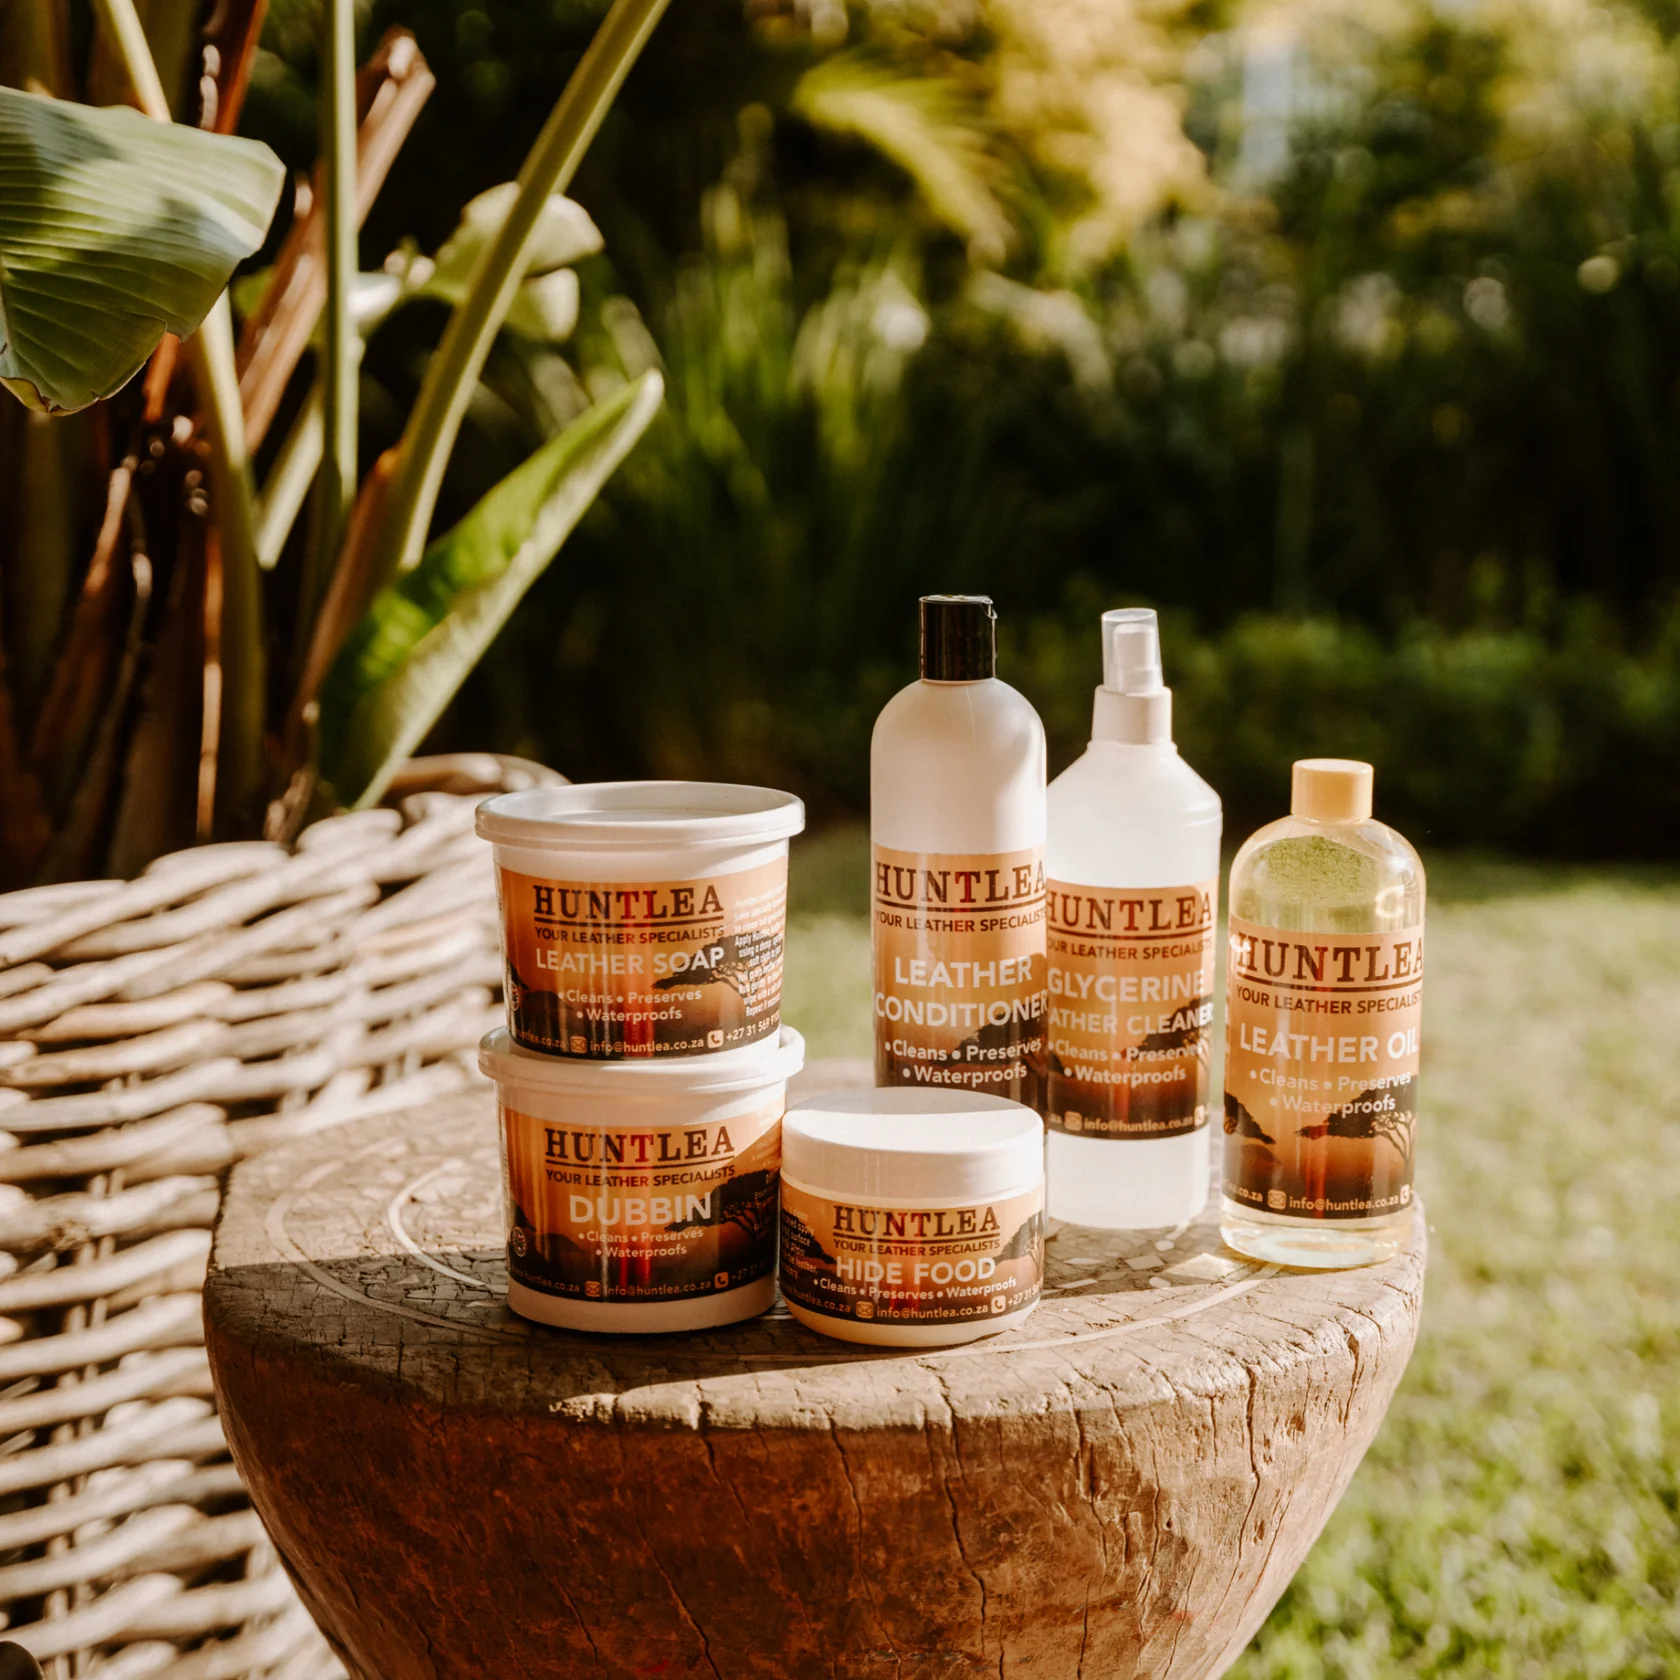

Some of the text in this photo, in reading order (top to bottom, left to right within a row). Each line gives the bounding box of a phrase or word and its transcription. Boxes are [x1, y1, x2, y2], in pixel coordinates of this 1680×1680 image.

[875, 860, 1046, 903] HUNTLEA
[533, 885, 724, 920] HUNTLEA
[534, 926, 724, 945] YOUR LEATHER SPECIALISTS
[906, 916, 975, 932] LEATHER
[536, 947, 644, 976] LEATHER
[653, 946, 724, 974] SOAP
[1071, 943, 1137, 960] LEATHER
[1237, 932, 1423, 982] HUNTLEA
[895, 955, 1032, 988] LEATHER
[567, 988, 702, 1005] Cleans Preserves
[1048, 967, 1205, 1003] GLYCERINE
[876, 989, 1047, 1027] CONDITIONER
[1236, 984, 1270, 1008] YOUR
[1275, 995, 1352, 1014] LEATHER
[586, 1008, 683, 1024] Waterproofs
[1049, 1007, 1117, 1035] ATHER
[590, 1036, 704, 1053] info@huntlea.co.za
[726, 1026, 745, 1042] +27
[746, 1024, 756, 1037] 31
[893, 1038, 1041, 1061] Cleans Preserves
[1056, 1039, 1108, 1062] Cleans
[1240, 1022, 1419, 1063] LEATHER OIL
[914, 1064, 1027, 1087] Waterproofs
[1075, 1064, 1186, 1088] Waterproofs
[1259, 1067, 1411, 1093] Cleans Preserves
[1282, 1094, 1396, 1118] Waterproofs
[545, 1126, 735, 1163] HUNTLEA
[546, 1165, 735, 1187] YOUR LEATHER SPECIALISTS
[569, 1192, 711, 1226] DUBBIN
[1289, 1193, 1399, 1212] info@huntlea.co.za
[833, 1205, 1000, 1237] HUNTLEA
[587, 1228, 704, 1244] Cleans Preserves
[834, 1239, 1000, 1257] YOUR LEATHER SPECIALISTS
[604, 1244, 687, 1260] Waterproofs
[836, 1256, 996, 1285] HIDE FOOD
[820, 1277, 1017, 1301] Cleans Preserves Waterproofs
[876, 1303, 989, 1320] info@huntlea.co.za
[1008, 1291, 1023, 1307] +27
[1024, 1287, 1032, 1301] 31
